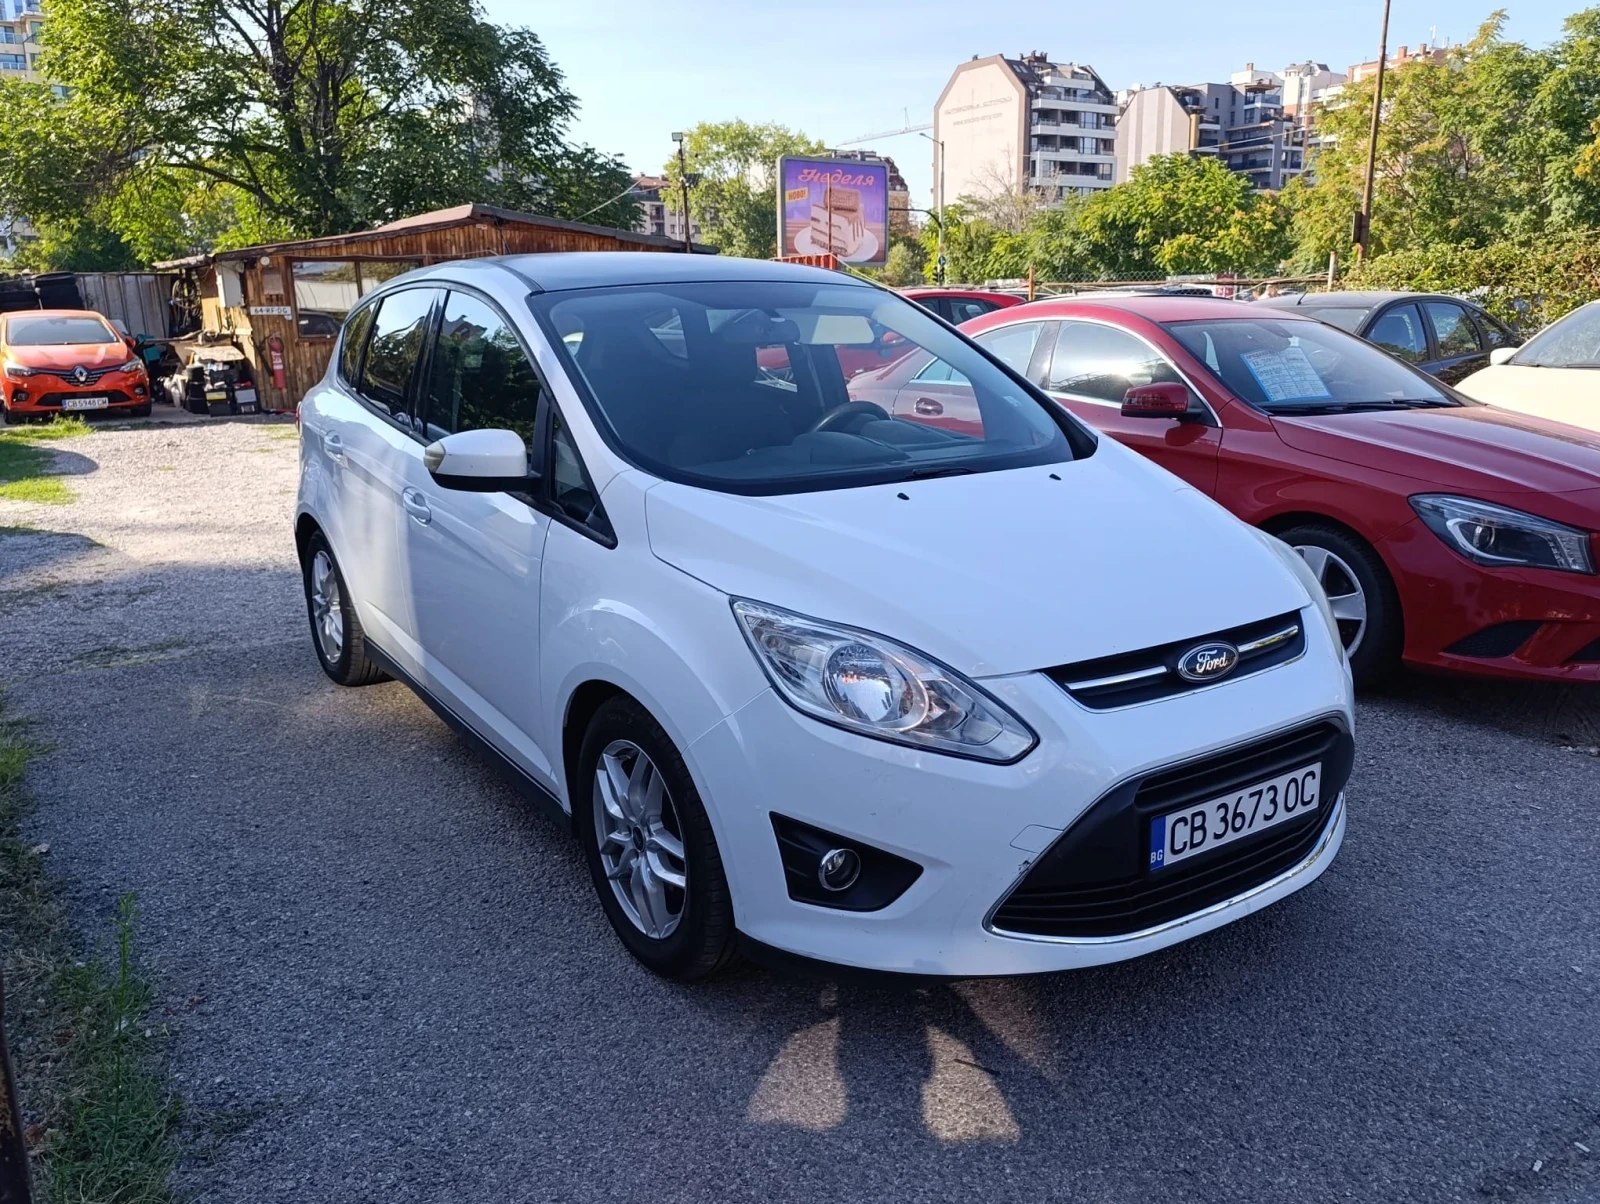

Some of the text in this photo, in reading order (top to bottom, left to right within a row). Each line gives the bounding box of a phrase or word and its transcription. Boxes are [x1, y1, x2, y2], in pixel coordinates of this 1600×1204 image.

[798, 168, 874, 186] Неделя
[1196, 649, 1228, 673] Ford
[1170, 810, 1207, 855] CB
[1213, 784, 1278, 840] 3673
[1150, 849, 1163, 864] BG
